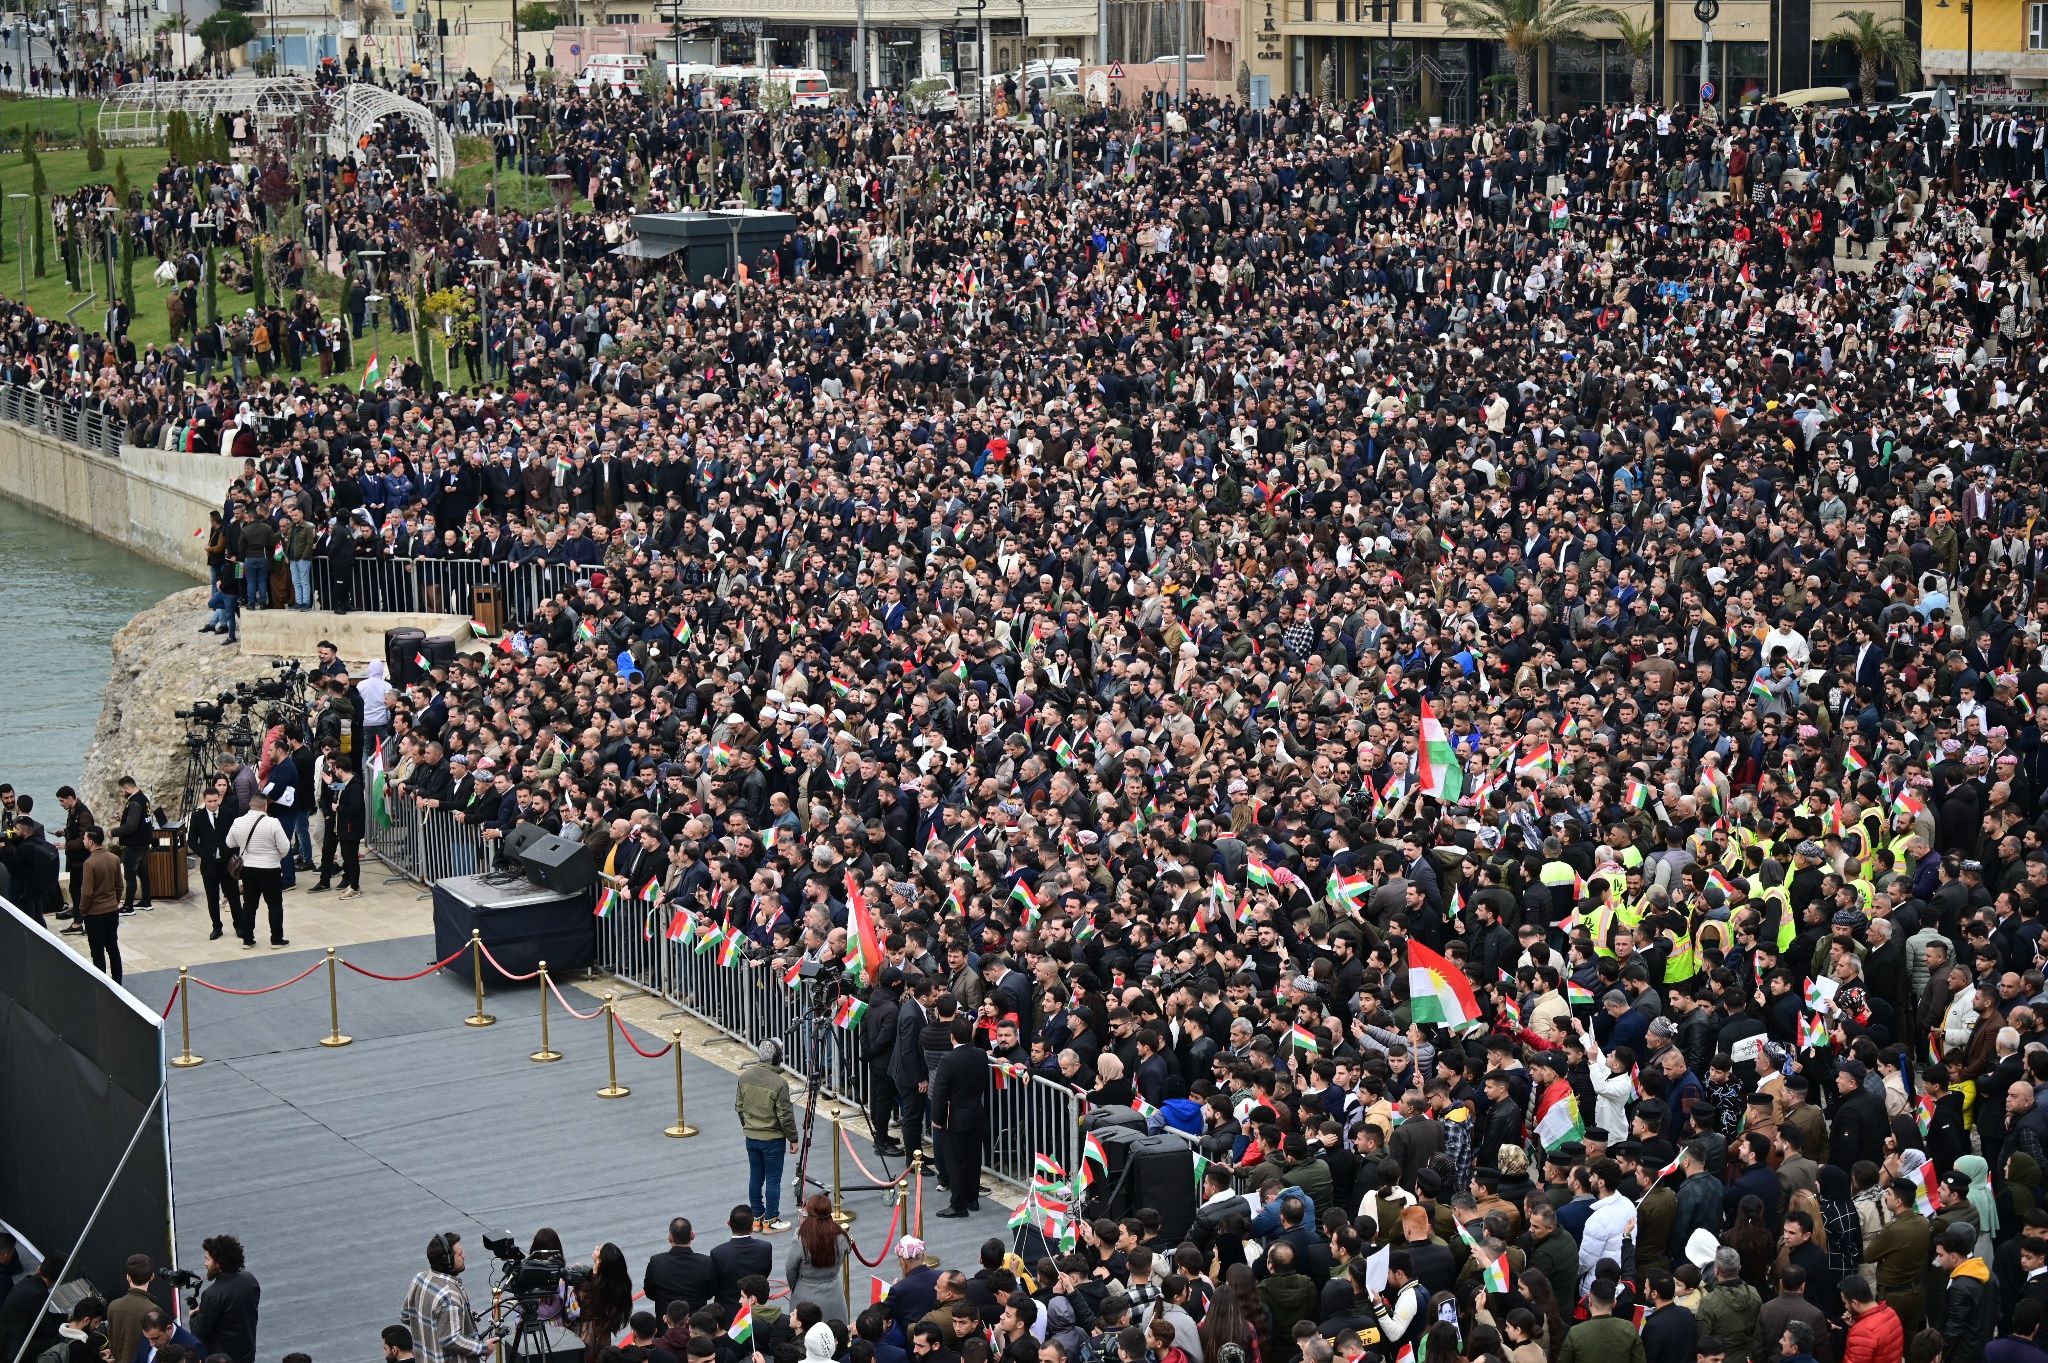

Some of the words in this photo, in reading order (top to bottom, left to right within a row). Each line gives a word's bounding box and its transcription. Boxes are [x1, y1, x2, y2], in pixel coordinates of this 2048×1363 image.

[1257, 33, 1281, 42] REST
[1265, 42, 1274, 51] &
[1257, 51, 1282, 60] CAFE
